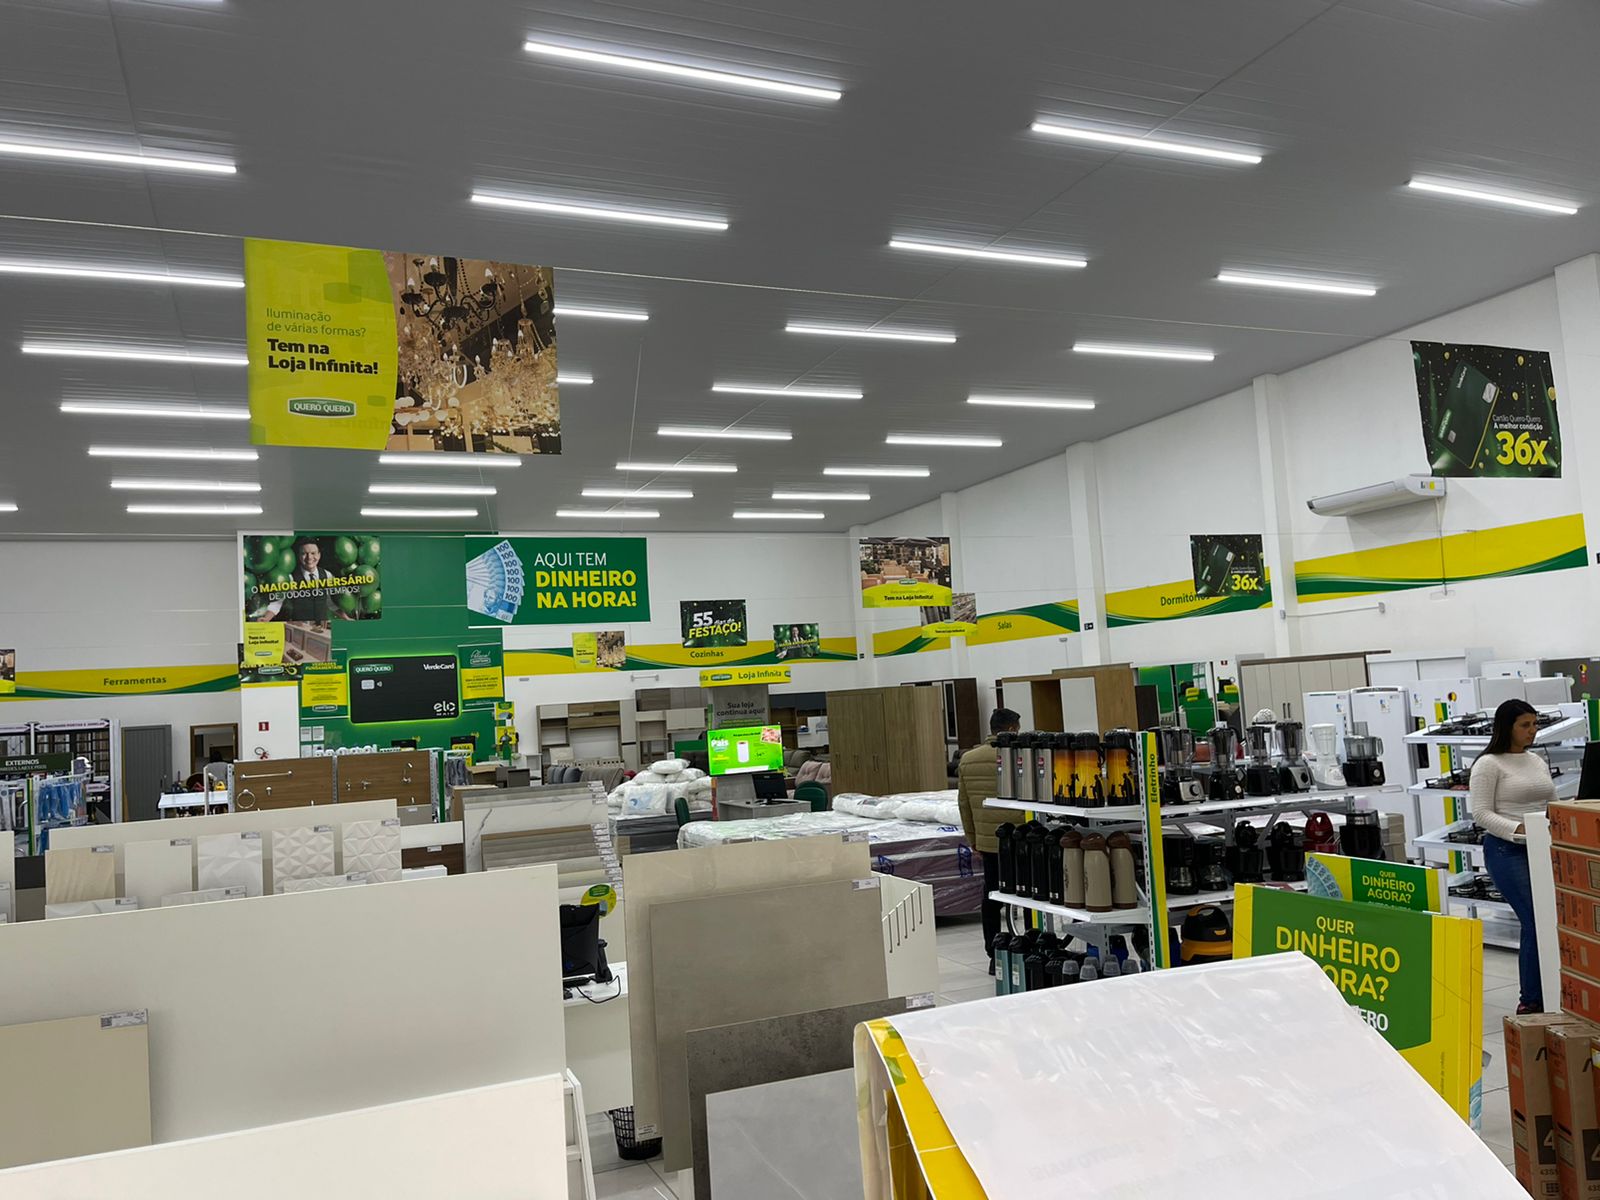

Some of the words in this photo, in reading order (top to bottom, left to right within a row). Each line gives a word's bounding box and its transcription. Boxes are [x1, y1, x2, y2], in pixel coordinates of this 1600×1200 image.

[266, 308, 332, 322] Iluminação
[266, 322, 281, 331] de
[285, 322, 318, 334] várias
[321, 325, 366, 337] formas?
[267, 338, 305, 353] Tem
[308, 343, 330, 354] na
[268, 355, 306, 372] Loja
[309, 358, 378, 374] Infinita!
[293, 402, 321, 412] QUERO
[323, 404, 350, 414] QUERO
[1499, 422, 1518, 430] melhor
[1519, 423, 1543, 431] condição
[1495, 431, 1548, 465] 36x
[496, 542, 510, 553] 100
[501, 551, 514, 560] 100
[534, 552, 572, 568] AQUI
[576, 553, 607, 566] TEM
[504, 560, 518, 569] 100
[506, 568, 520, 576] 100
[251, 585, 258, 594] O
[259, 581, 298, 593] MAIOR
[299, 574, 374, 590] ANIVERSÁRIO
[535, 570, 637, 588] DINHEIRO
[1231, 574, 1259, 590] 36x
[268, 592, 281, 601] DE
[282, 589, 312, 600] TODOS
[312, 587, 324, 597] OS
[326, 585, 360, 596] TEMPOS!
[507, 585, 520, 594] 100
[505, 593, 518, 602] 100
[537, 591, 568, 608] NA
[572, 591, 637, 608] HORA!
[692, 611, 713, 628] 55
[997, 621, 1012, 630] Salas
[688, 621, 742, 639] FESTAÇO!
[690, 650, 724, 659] Cozinhas
[103, 676, 167, 686] Ferramentas
[738, 671, 756, 680] Loja
[757, 670, 782, 678] Infinita
[716, 708, 747, 716] continua
[741, 701, 754, 709] loja
[5, 758, 40, 766] EXTERNOS
[1149, 753, 1158, 803] Eletrinho
[1379, 870, 1396, 878] QUER
[1362, 875, 1416, 892] DINHEIRO
[1367, 888, 1412, 904] AGORA?
[1316, 916, 1354, 936] QUER
[1276, 926, 1400, 974] DINHEIRO
[1321, 964, 1390, 1002] ORA?
